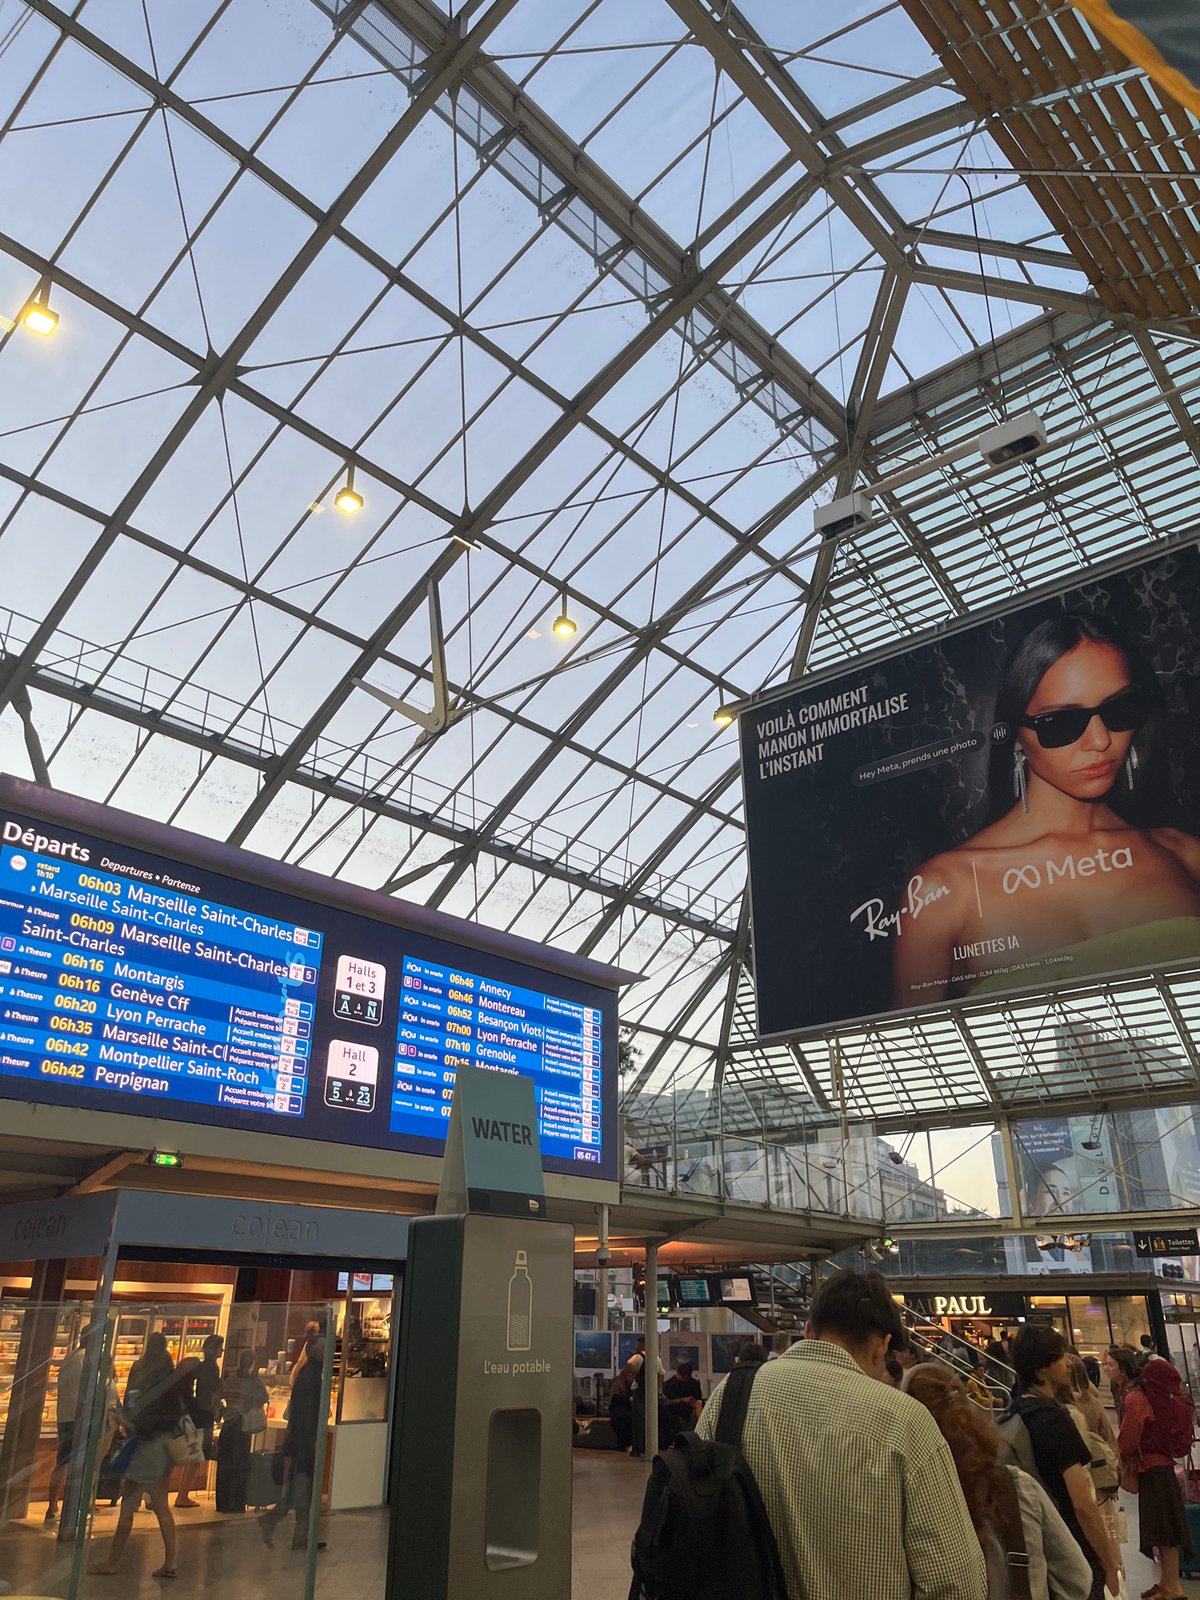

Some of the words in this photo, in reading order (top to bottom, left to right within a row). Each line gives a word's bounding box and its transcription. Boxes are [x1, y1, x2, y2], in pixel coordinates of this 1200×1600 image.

[756, 709, 796, 740] VOILÀ
[799, 685, 868, 725] COMMENT
[758, 728, 807, 760] MANON
[810, 693, 909, 742] IMMORTALISE
[759, 743, 824, 780] L'INSTANT
[859, 769, 876, 781] Hey
[877, 763, 901, 776] Meta,
[902, 752, 932, 769] prends
[932, 747, 949, 758] une
[950, 738, 978, 753] photo
[3, 821, 91, 862] Départs
[36, 869, 54, 880] 1h10
[37, 863, 60, 873] retard
[100, 857, 153, 880] Departures
[162, 874, 201, 894] Partenze
[1045, 847, 1133, 885] Meta
[39, 881, 108, 911] Marseille
[111, 900, 204, 935] Saint-Charles
[78, 874, 122, 896] 06h03
[127, 884, 197, 917] Marseille
[200, 905, 293, 942] Saint-Charles
[22, 920, 125, 956] Saint-Charles
[34, 907, 60, 920] l'heure
[70, 913, 115, 935] 06h09
[121, 923, 191, 954] Marseille
[195, 942, 289, 977] Saint-Charles
[953, 937, 1006, 961] LUNETTES
[1008, 934, 1020, 950] IA
[25, 946, 52, 958] l'heure
[63, 952, 104, 972] 06h16
[114, 961, 185, 991] Montargis
[306, 971, 312, 979] 5
[348, 961, 377, 979] Halls
[21, 967, 48, 980] l'heure
[59, 973, 101, 993] 06h16
[111, 983, 164, 1006] Genève
[168, 995, 190, 1011] Cff
[346, 976, 353, 988] 1
[355, 982, 366, 992] et
[368, 982, 376, 994] 3
[450, 973, 474, 988] 06h46
[479, 980, 512, 1000] Annecy
[17, 989, 43, 1001] l'heure
[54, 995, 97, 1014] 06h20
[107, 1003, 142, 1022] Lyon
[146, 1011, 206, 1035] Perrache
[340, 1001, 350, 1012] A
[367, 1006, 376, 1018] N
[448, 989, 473, 1004] 06h46
[478, 995, 525, 1018] Montereau
[448, 1005, 472, 1020] 06h52
[478, 1012, 519, 1032] Besançon
[12, 1011, 39, 1023] l'heure
[50, 1016, 93, 1035] 06h35
[102, 1024, 169, 1048] Marseille
[172, 1037, 225, 1059] Saint-C
[445, 1038, 470, 1053] 07h10
[476, 1044, 516, 1063] Grenoble
[446, 1021, 471, 1036] 07h00
[477, 1028, 498, 1043] Lyon
[500, 1033, 537, 1052] Perrache
[7, 1033, 34, 1045] l'heure
[45, 1037, 89, 1057] 06h42
[99, 1045, 184, 1072] Montpellier
[187, 1060, 259, 1085] Saint-Roch
[343, 1047, 366, 1062] Hall
[348, 1063, 357, 1077] 2
[41, 1059, 85, 1079] 06h42
[95, 1066, 169, 1091] Perpignan
[332, 1086, 340, 1099] 5
[358, 1090, 371, 1104] 23
[471, 1117, 533, 1146] WATER
[231, 1209, 319, 1247] cojean
[935, 1296, 993, 1315] PAUL
[484, 1360, 509, 1374] L'eau
[512, 1359, 551, 1377] potable
